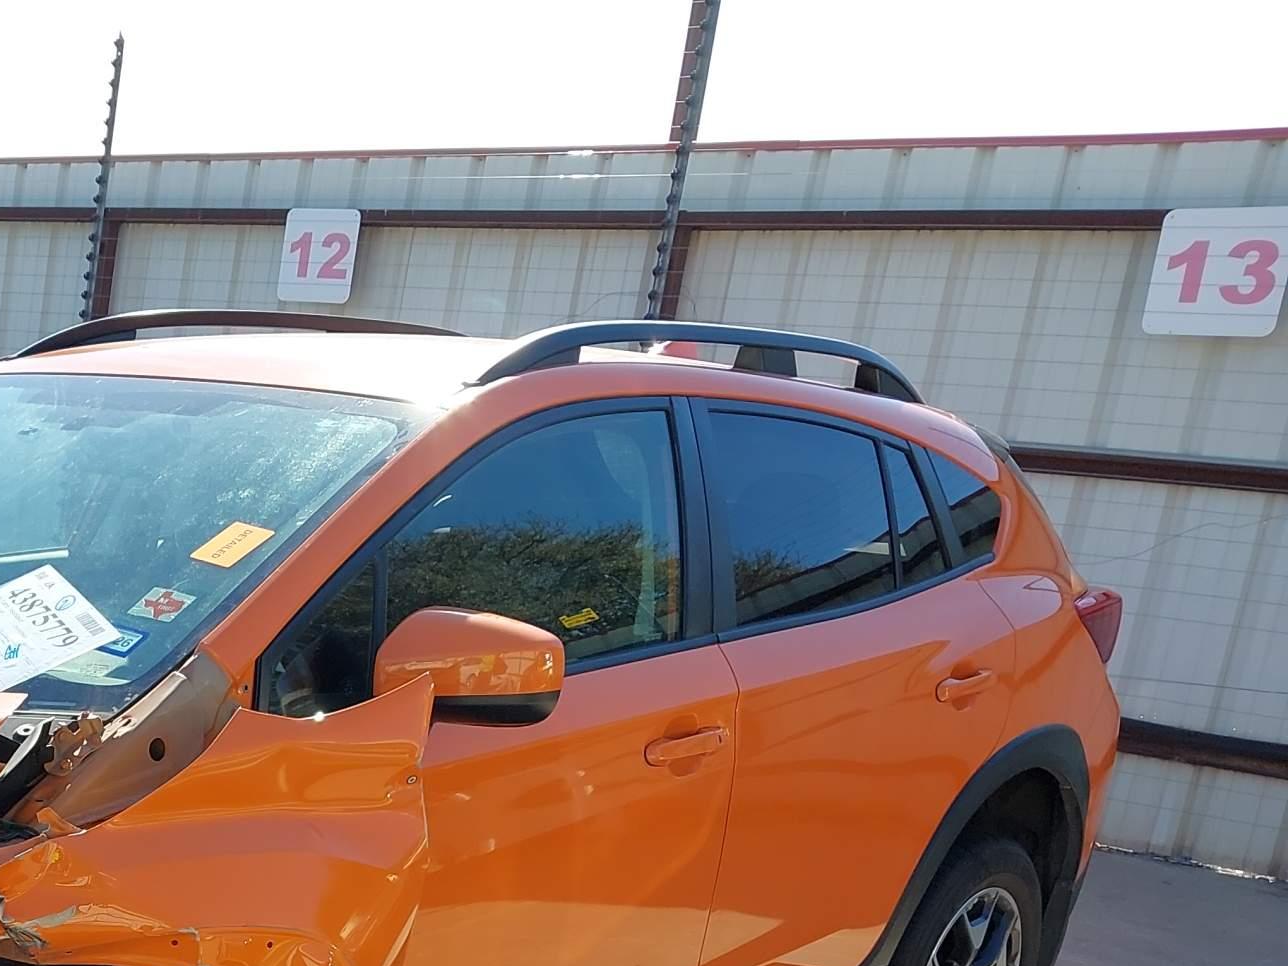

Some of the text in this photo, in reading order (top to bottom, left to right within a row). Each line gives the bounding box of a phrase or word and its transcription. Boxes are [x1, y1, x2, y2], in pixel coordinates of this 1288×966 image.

[289, 231, 351, 280] 12
[1166, 239, 1280, 305] 13
[211, 529, 254, 559] DETAILED
[8, 588, 80, 648] 43875779
[113, 636, 133, 648] 26
